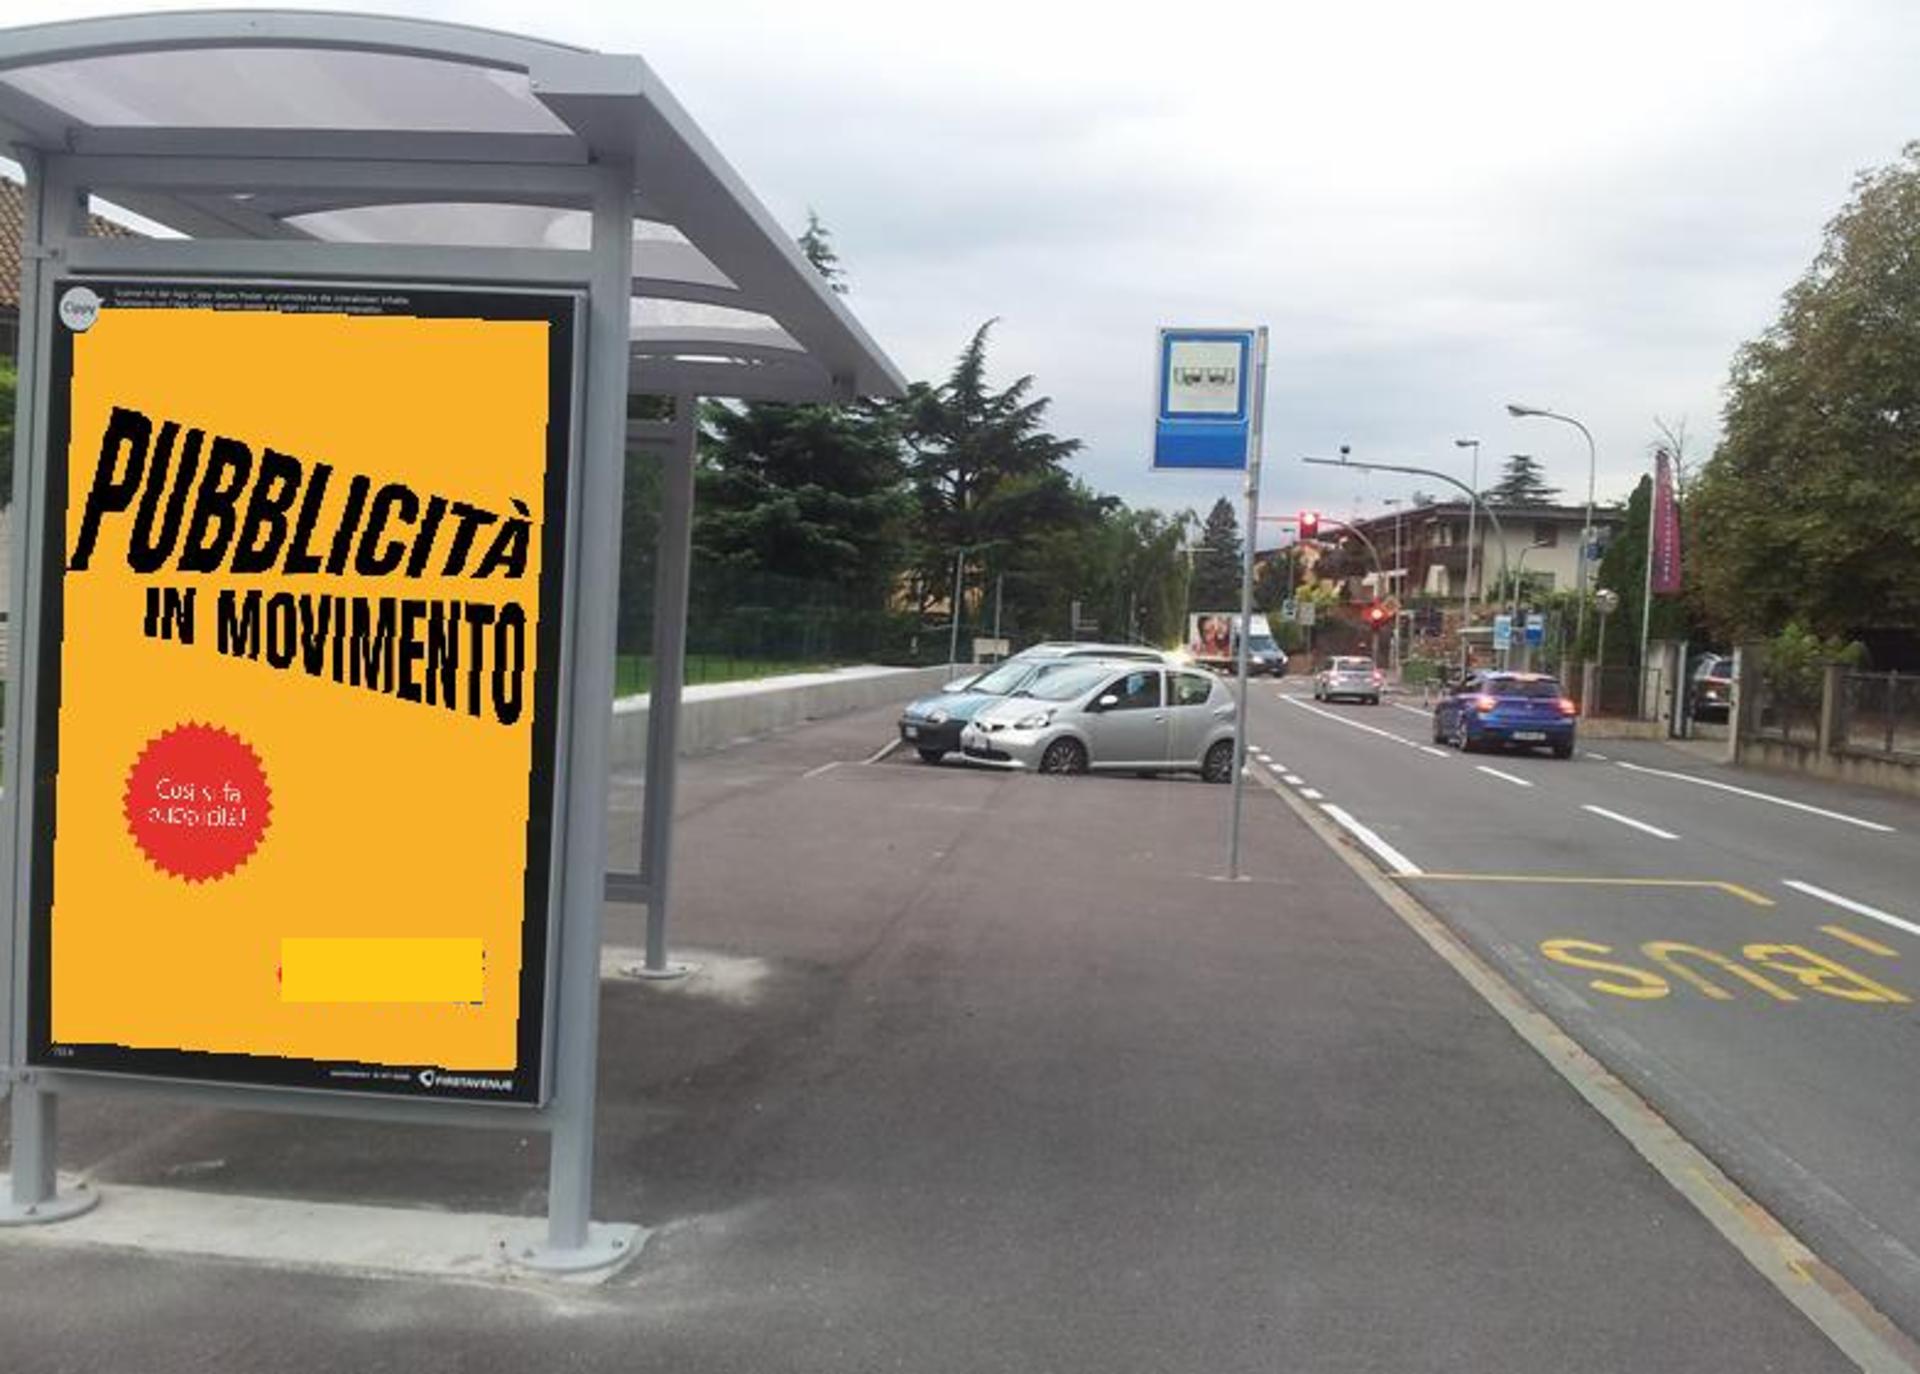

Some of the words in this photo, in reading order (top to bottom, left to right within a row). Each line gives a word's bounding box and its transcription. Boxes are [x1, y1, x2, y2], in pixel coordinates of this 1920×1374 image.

[67, 406, 532, 579] PUBBLICITÀ
[144, 586, 196, 644] IN
[217, 588, 527, 725] MOVIMENTO
[1540, 939, 1912, 1002] BUS
